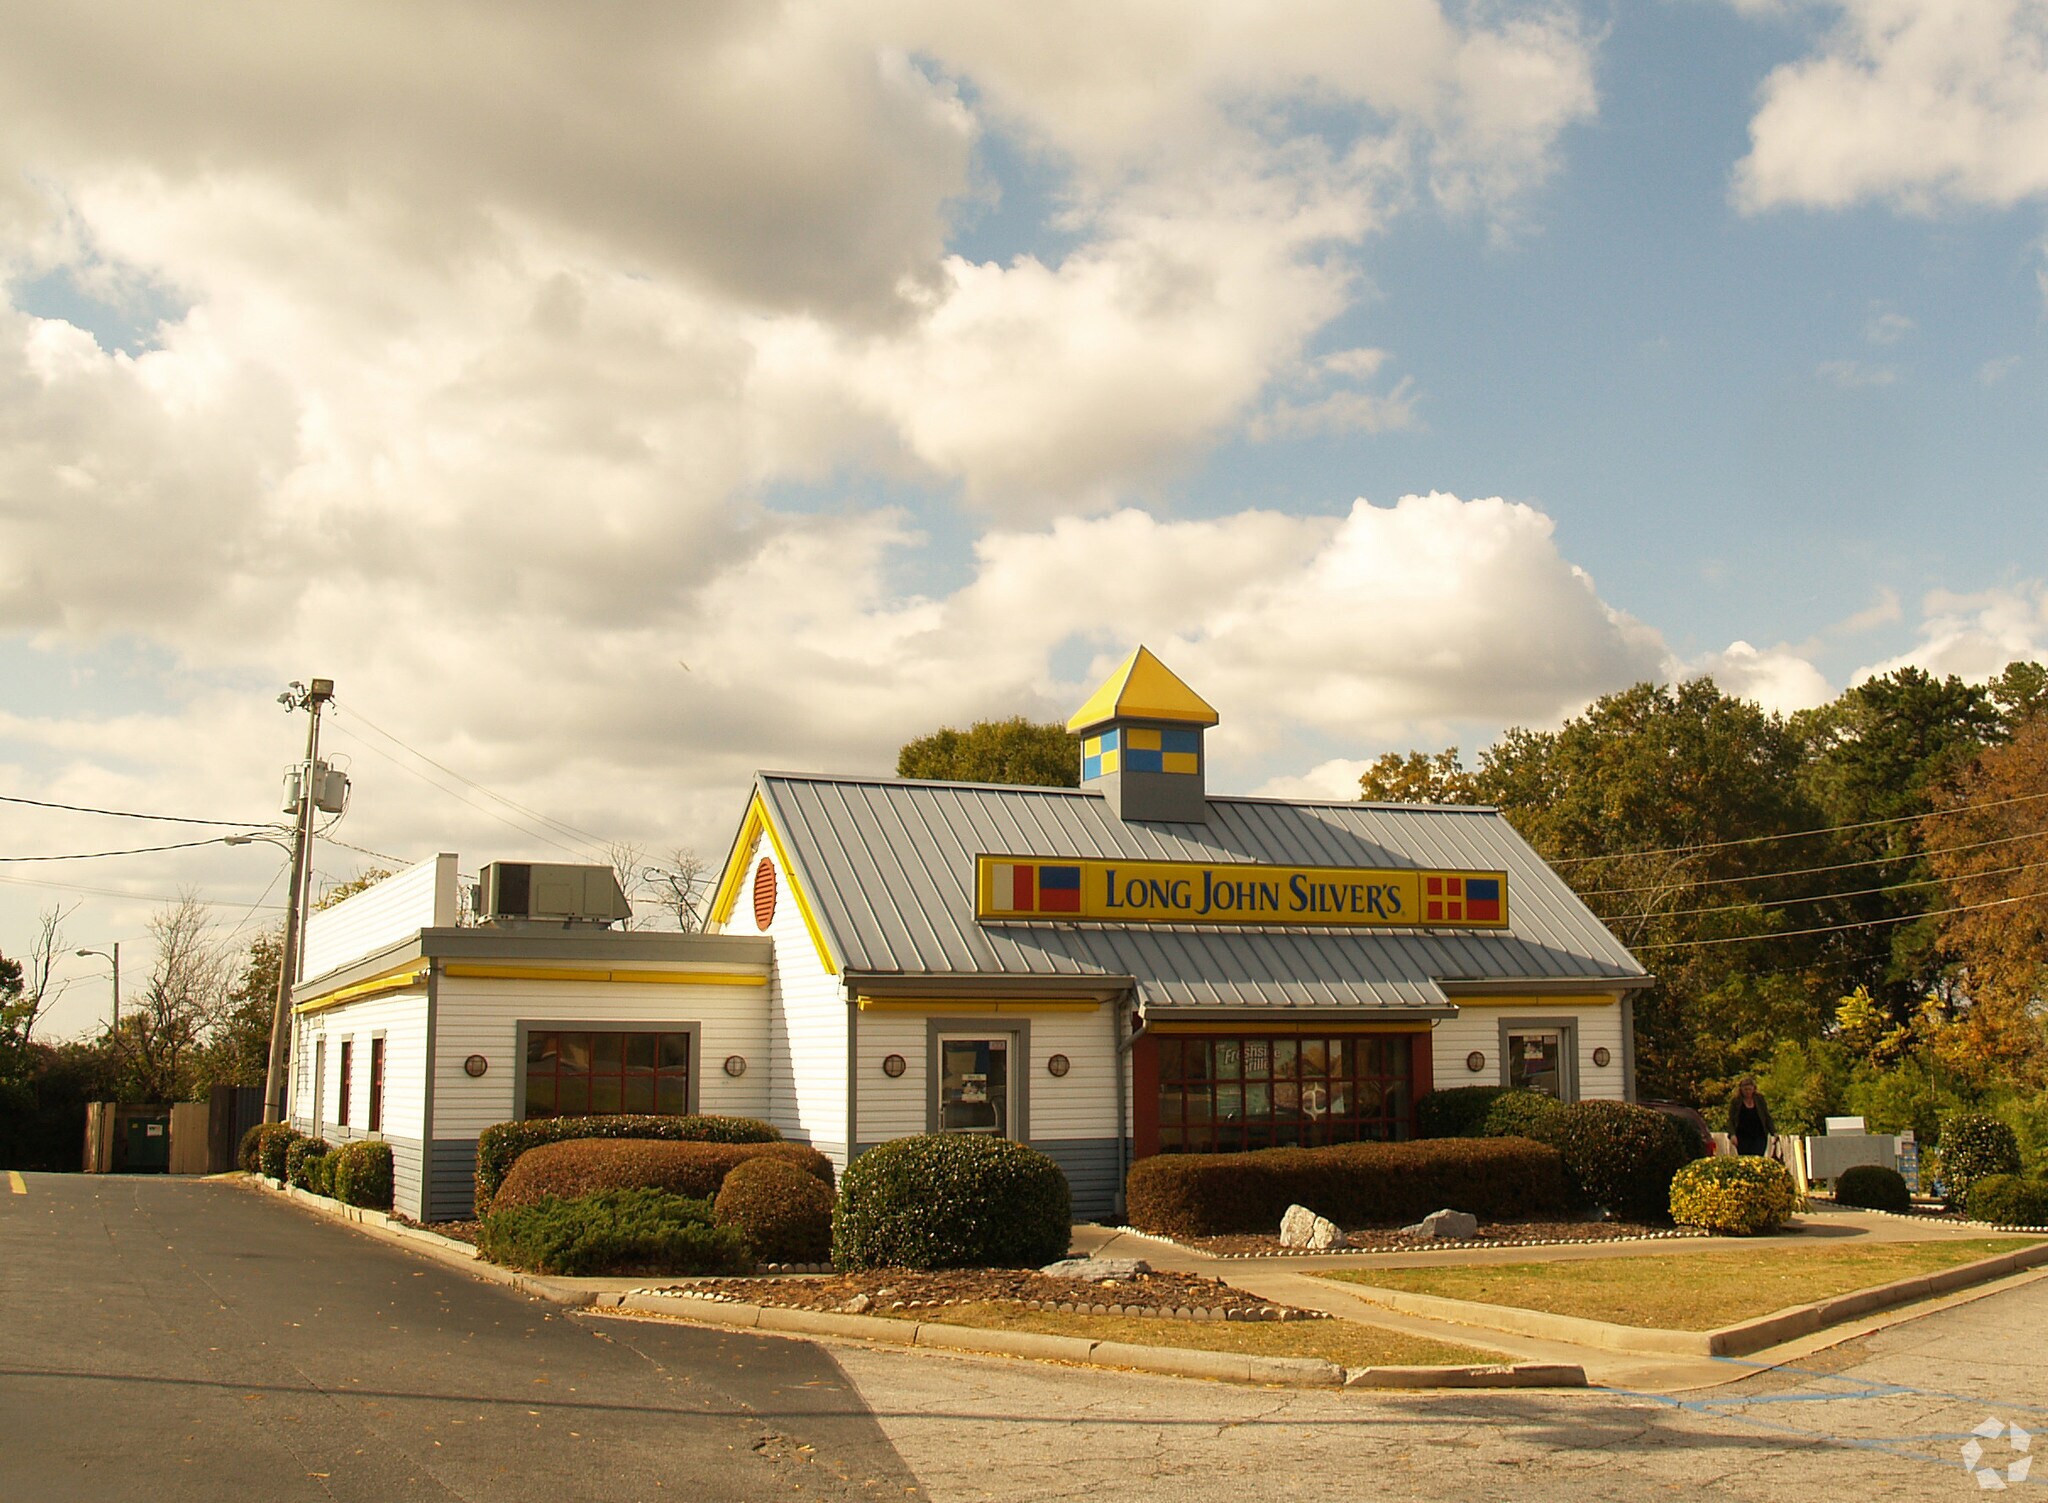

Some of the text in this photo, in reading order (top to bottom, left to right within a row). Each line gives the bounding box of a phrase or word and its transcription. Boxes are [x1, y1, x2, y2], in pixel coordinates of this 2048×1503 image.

[1105, 869, 1402, 920] LONG JOHN SILVER'S
[1224, 1044, 1281, 1065] Freshsie
